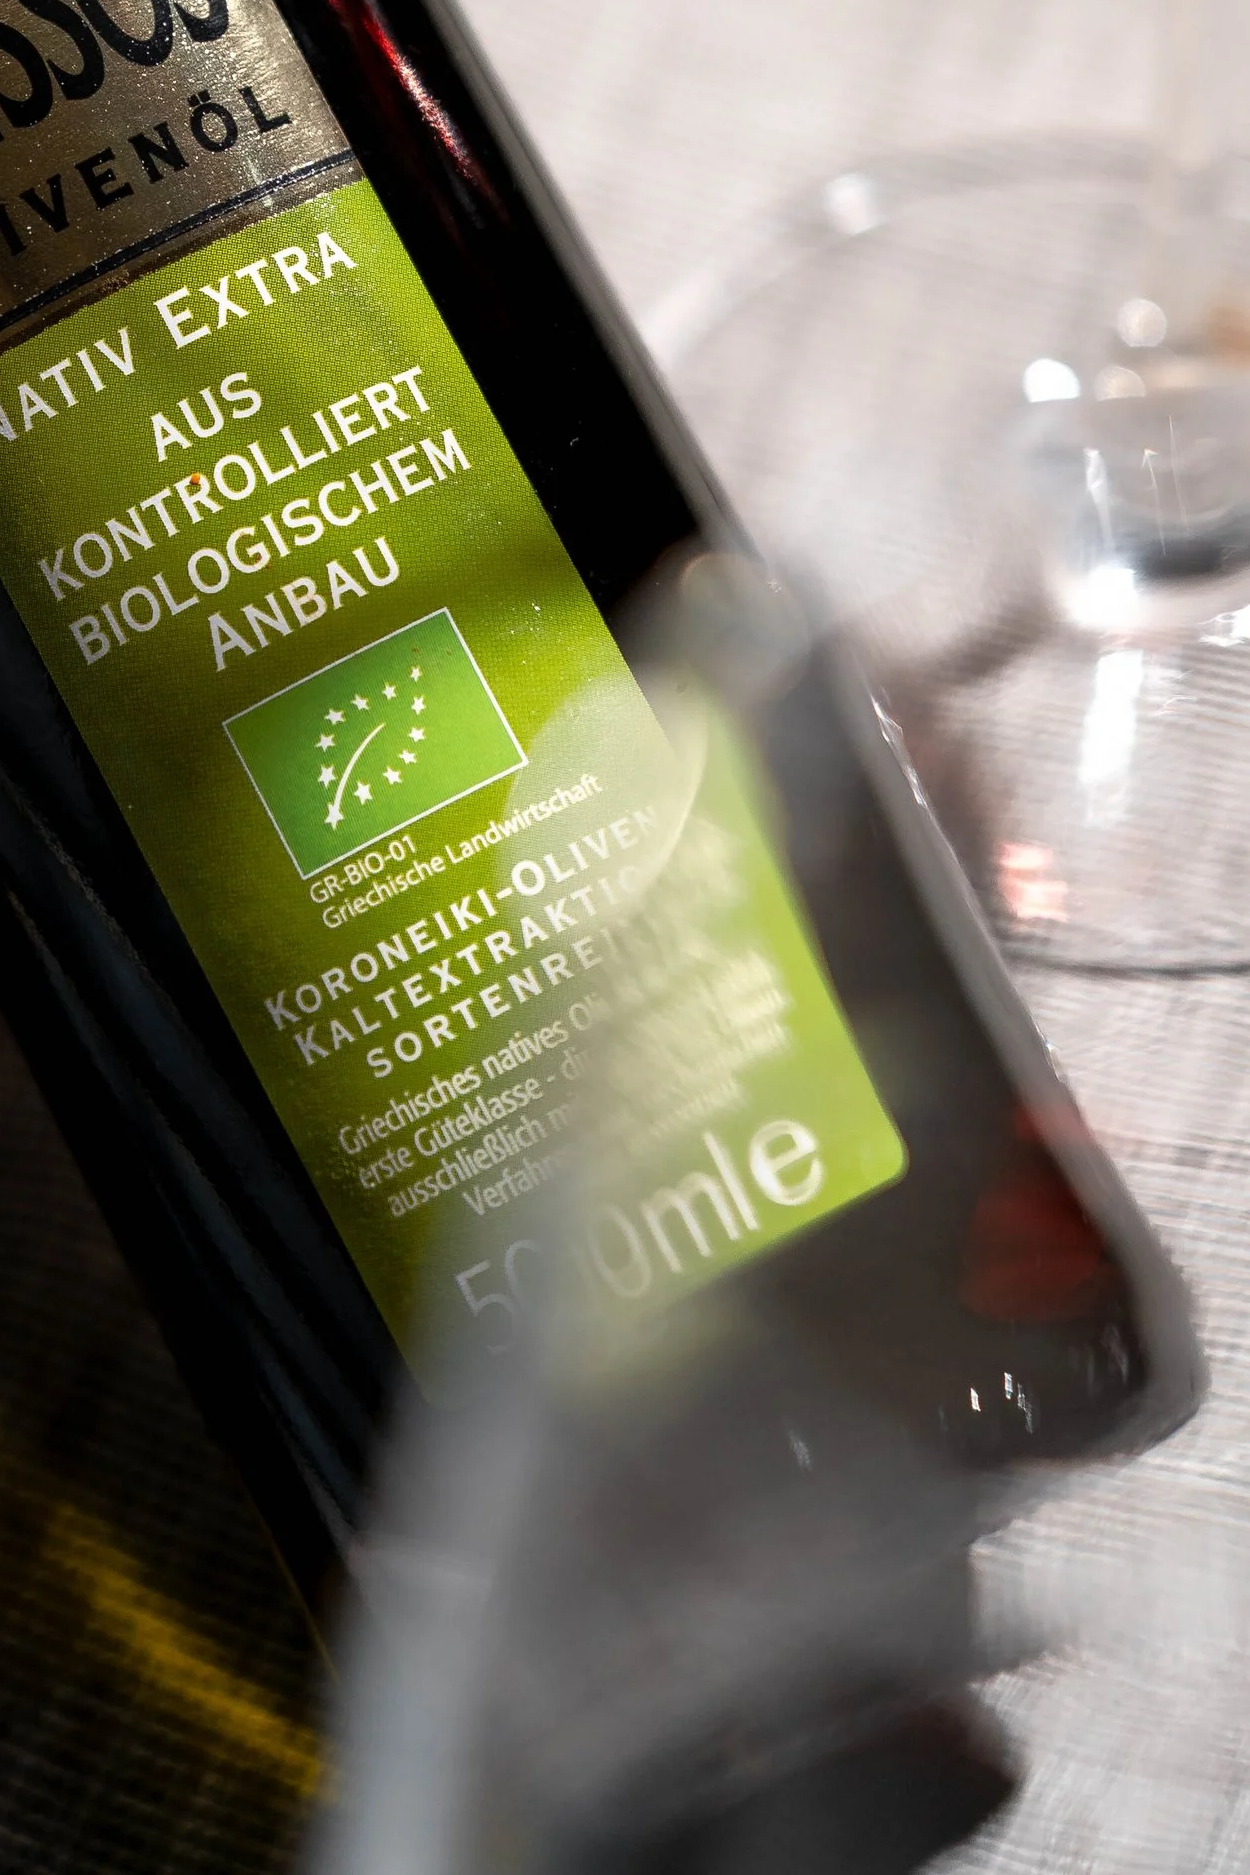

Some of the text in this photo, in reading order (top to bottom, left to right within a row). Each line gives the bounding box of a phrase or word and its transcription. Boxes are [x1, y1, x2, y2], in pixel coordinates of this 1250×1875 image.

[153, 231, 358, 349] EXTRA
[37, 365, 433, 602] KONTROLLIERT
[150, 371, 263, 462] AUS
[69, 428, 472, 665] BIOLOGISCHEM
[206, 536, 401, 671] ANBAU
[309, 835, 416, 905] GR-BIO-01
[321, 772, 604, 930] Griechische Landwirtschaft
[293, 855, 656, 1067] KALTEXTRAKTIO
[365, 921, 635, 1079] SORTENREI
[338, 1065, 482, 1156] Griechisches
[481, 1021, 571, 1085] natives
[358, 1141, 414, 1189] erste
[413, 1073, 544, 1157] Güteklasse
[387, 1111, 548, 1220] ausschließlich
